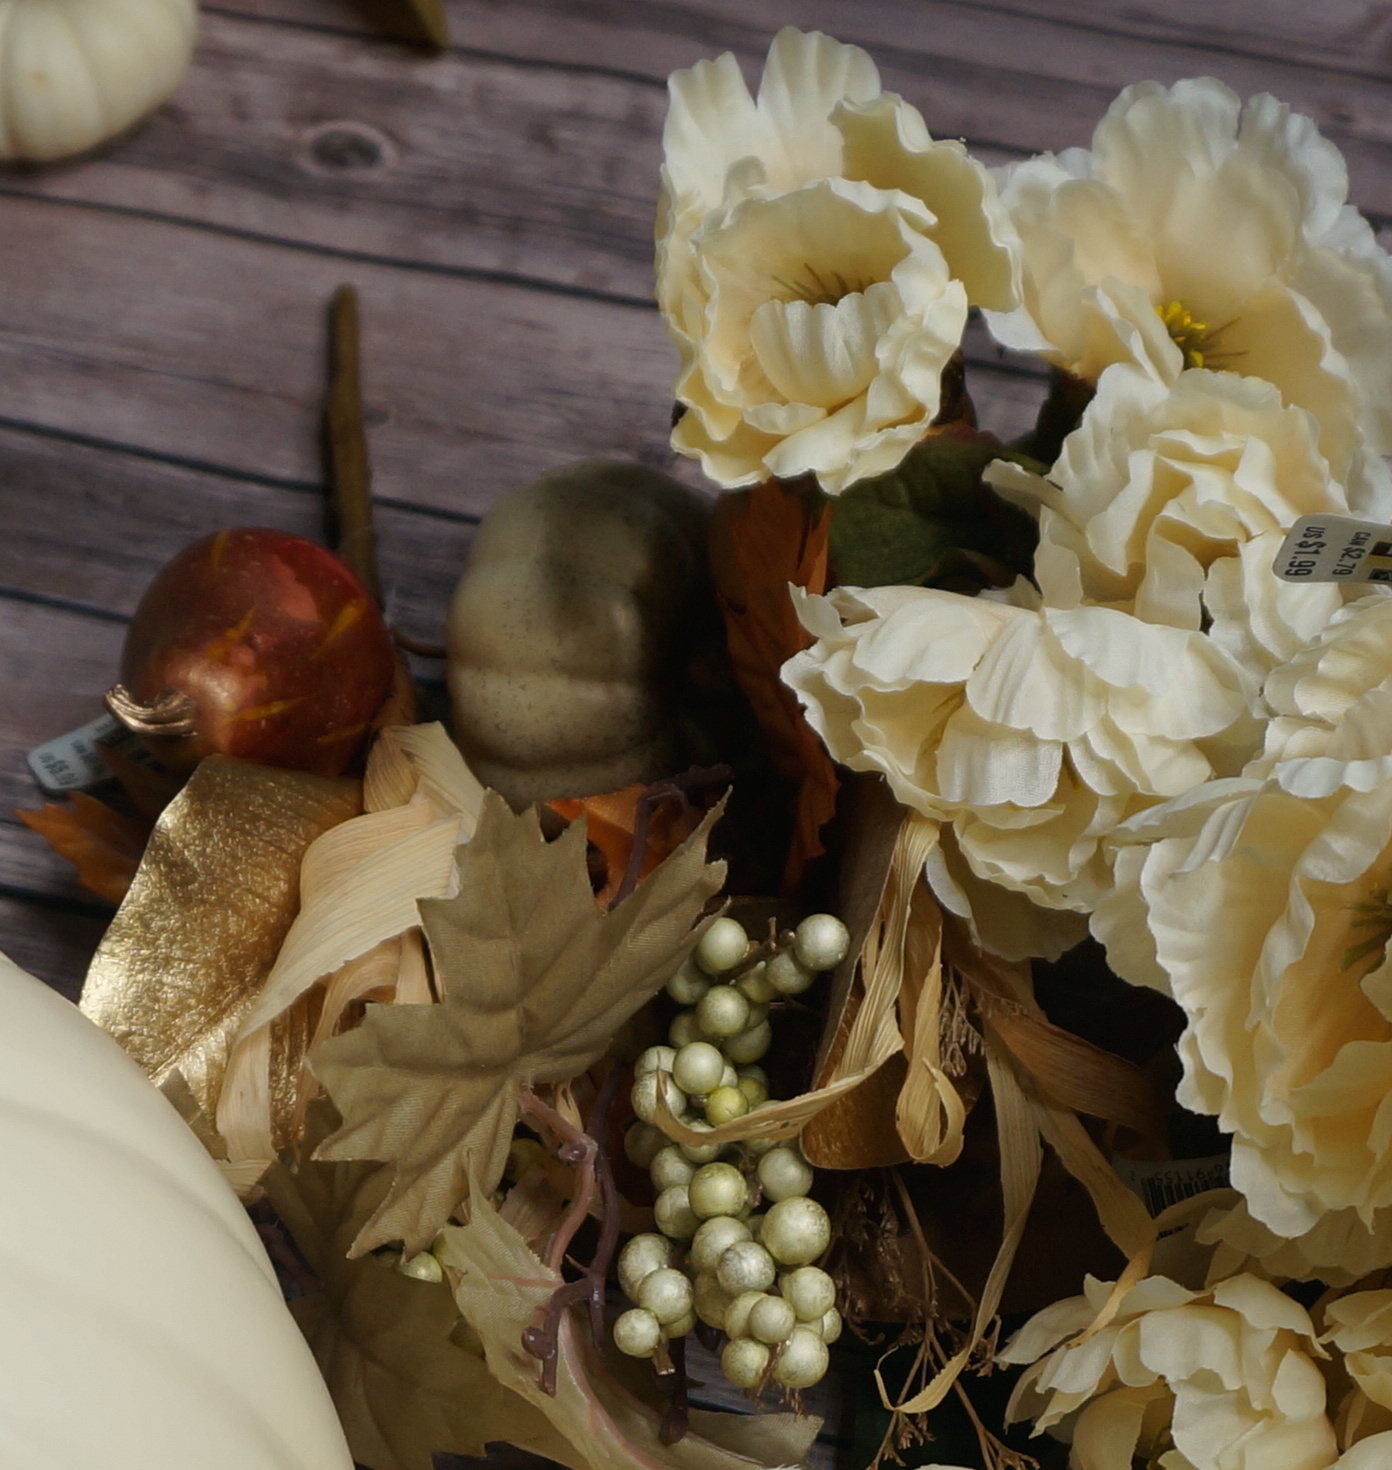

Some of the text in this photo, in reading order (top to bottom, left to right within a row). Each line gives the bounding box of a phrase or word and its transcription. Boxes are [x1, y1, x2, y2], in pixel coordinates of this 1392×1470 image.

[1284, 526, 1326, 576] US $1.99
[1332, 531, 1371, 575] CAN $2.79
